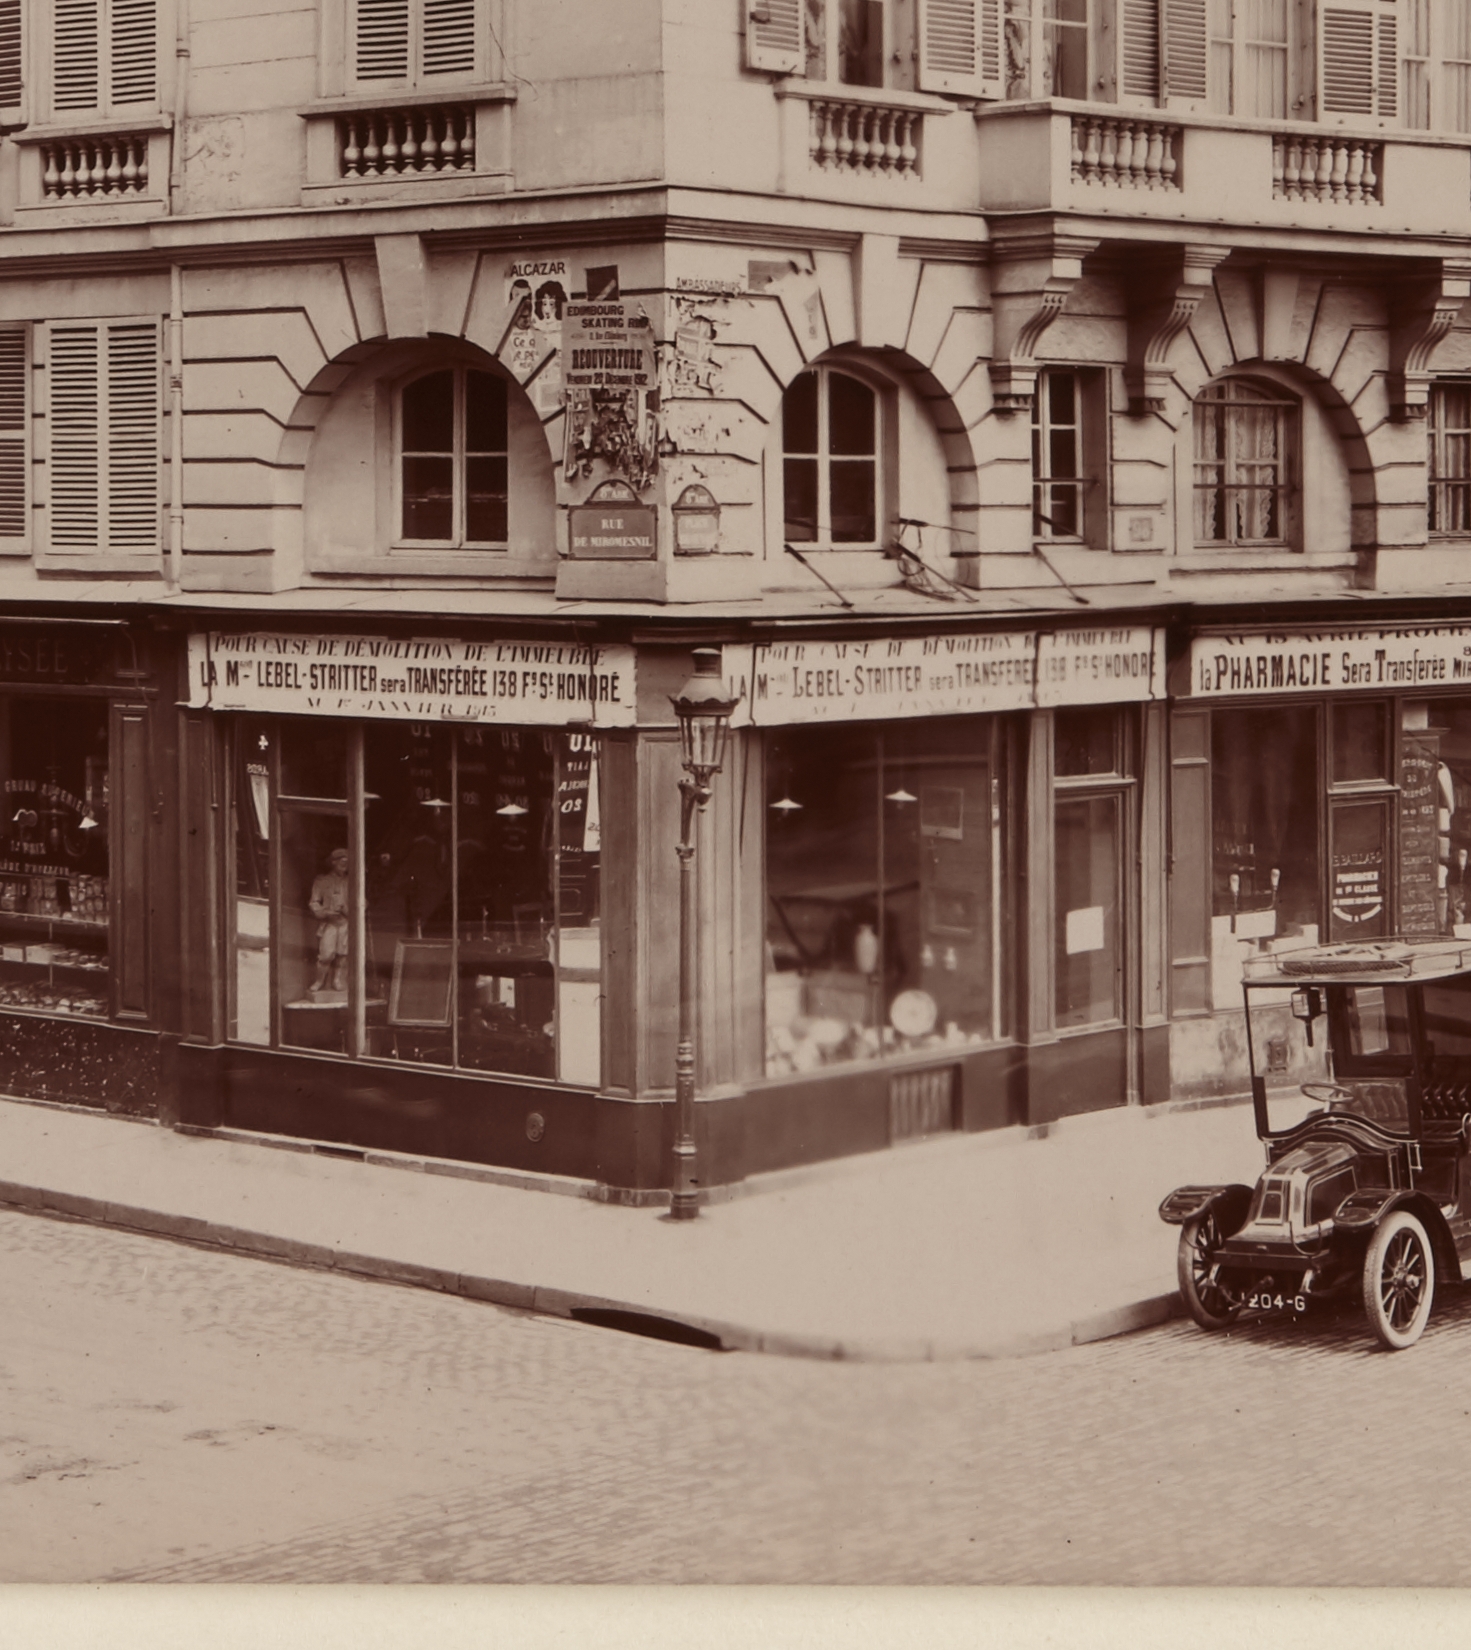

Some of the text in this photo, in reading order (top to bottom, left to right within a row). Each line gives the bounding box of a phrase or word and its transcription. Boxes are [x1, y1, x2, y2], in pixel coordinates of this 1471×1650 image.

[510, 261, 566, 277] ALCAZAR
[581, 317, 624, 329] SKATING
[572, 348, 644, 370] RÉOUVERTURE
[601, 518, 625, 530] RUE
[574, 536, 653, 547] DE MIROMESNIL
[214, 635, 607, 667] POUR CAUSE DE DÉMOLITION DE L'IMMEUBLE
[200, 661, 219, 687] LA
[256, 660, 377, 692] LEBEL-STRITTER
[380, 678, 406, 694] sera
[407, 664, 488, 697] TRANSFÉRÉE
[492, 670, 518, 698] 138
[557, 671, 621, 703] HONORÉ
[792, 664, 922, 699] LEBEL-STRITTER
[929, 674, 954, 691] sera
[1199, 658, 1212, 691] la
[1214, 652, 1332, 691] PHARMACIE
[1341, 651, 1372, 684] Sera
